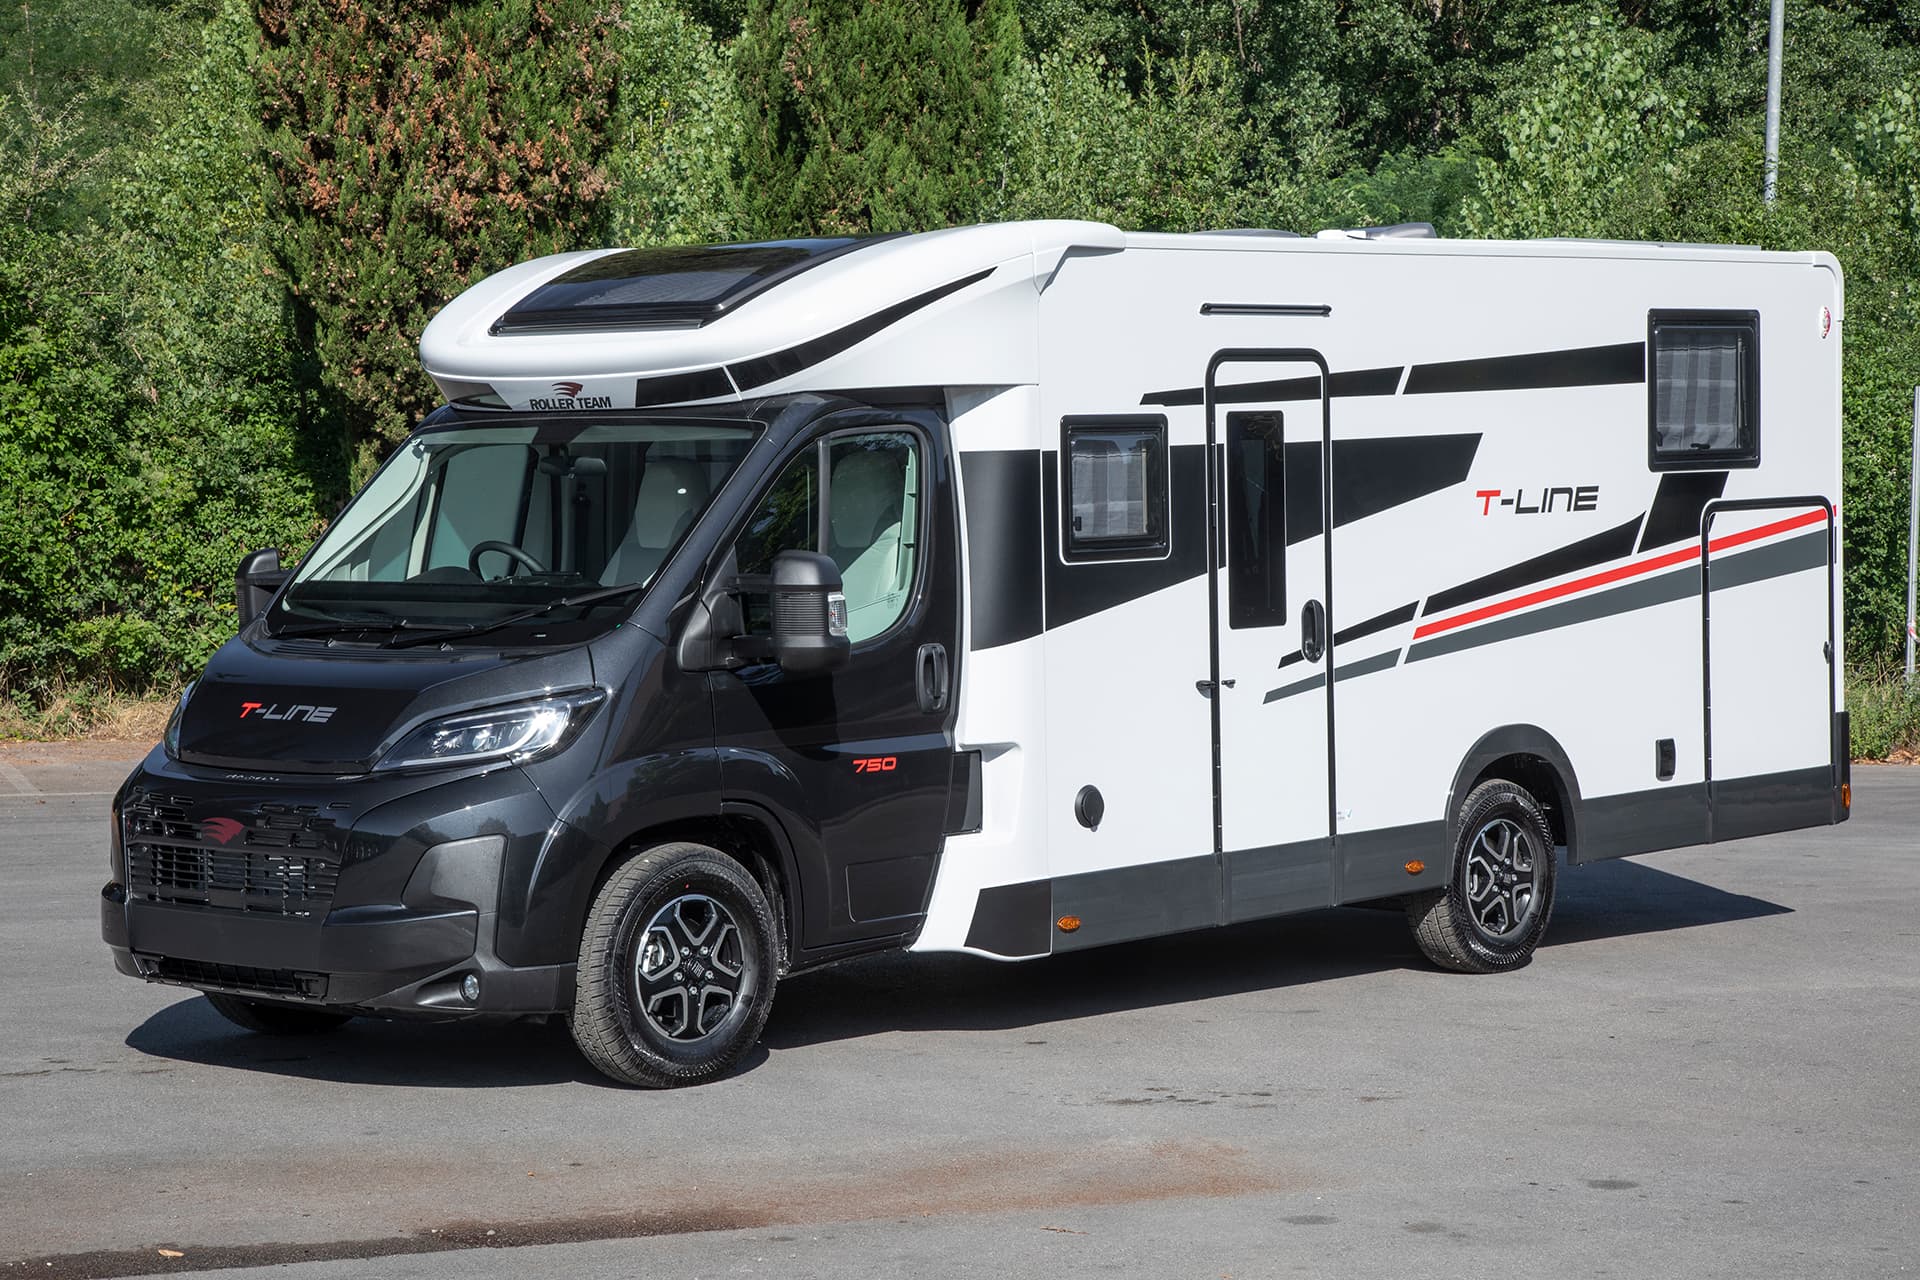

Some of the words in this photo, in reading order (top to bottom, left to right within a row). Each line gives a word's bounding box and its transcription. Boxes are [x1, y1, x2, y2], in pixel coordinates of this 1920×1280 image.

[529, 398, 575, 410] ROLLER
[576, 396, 612, 409] TEAM
[1475, 485, 1600, 516] T-LINE
[239, 702, 338, 723] T-LINE
[853, 756, 897, 774] 750
